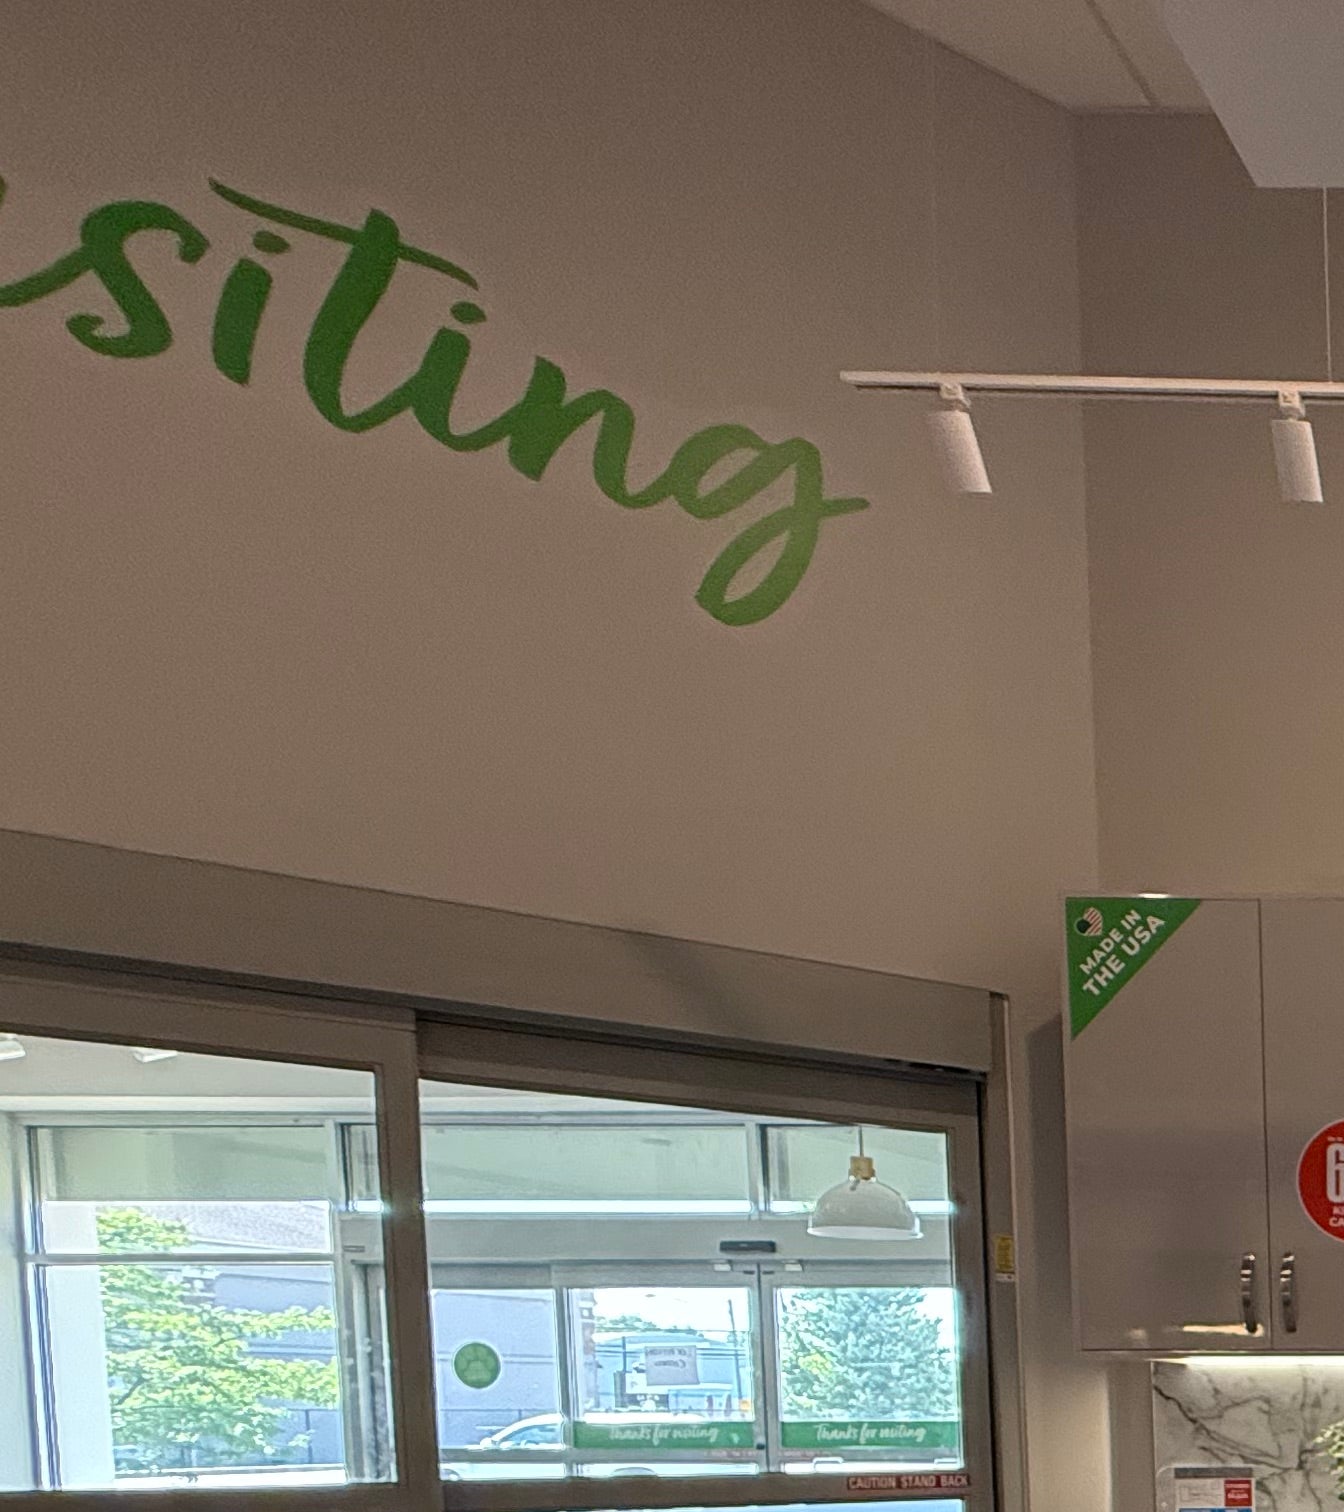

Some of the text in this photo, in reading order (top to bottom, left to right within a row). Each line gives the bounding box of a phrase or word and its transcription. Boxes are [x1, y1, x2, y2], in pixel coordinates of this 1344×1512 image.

[0, 178, 869, 626] siting
[1079, 909, 1142, 975] MADE IN
[1082, 915, 1166, 996] THE USA
[848, 1474, 969, 1489] CAUTION STAND BACK
